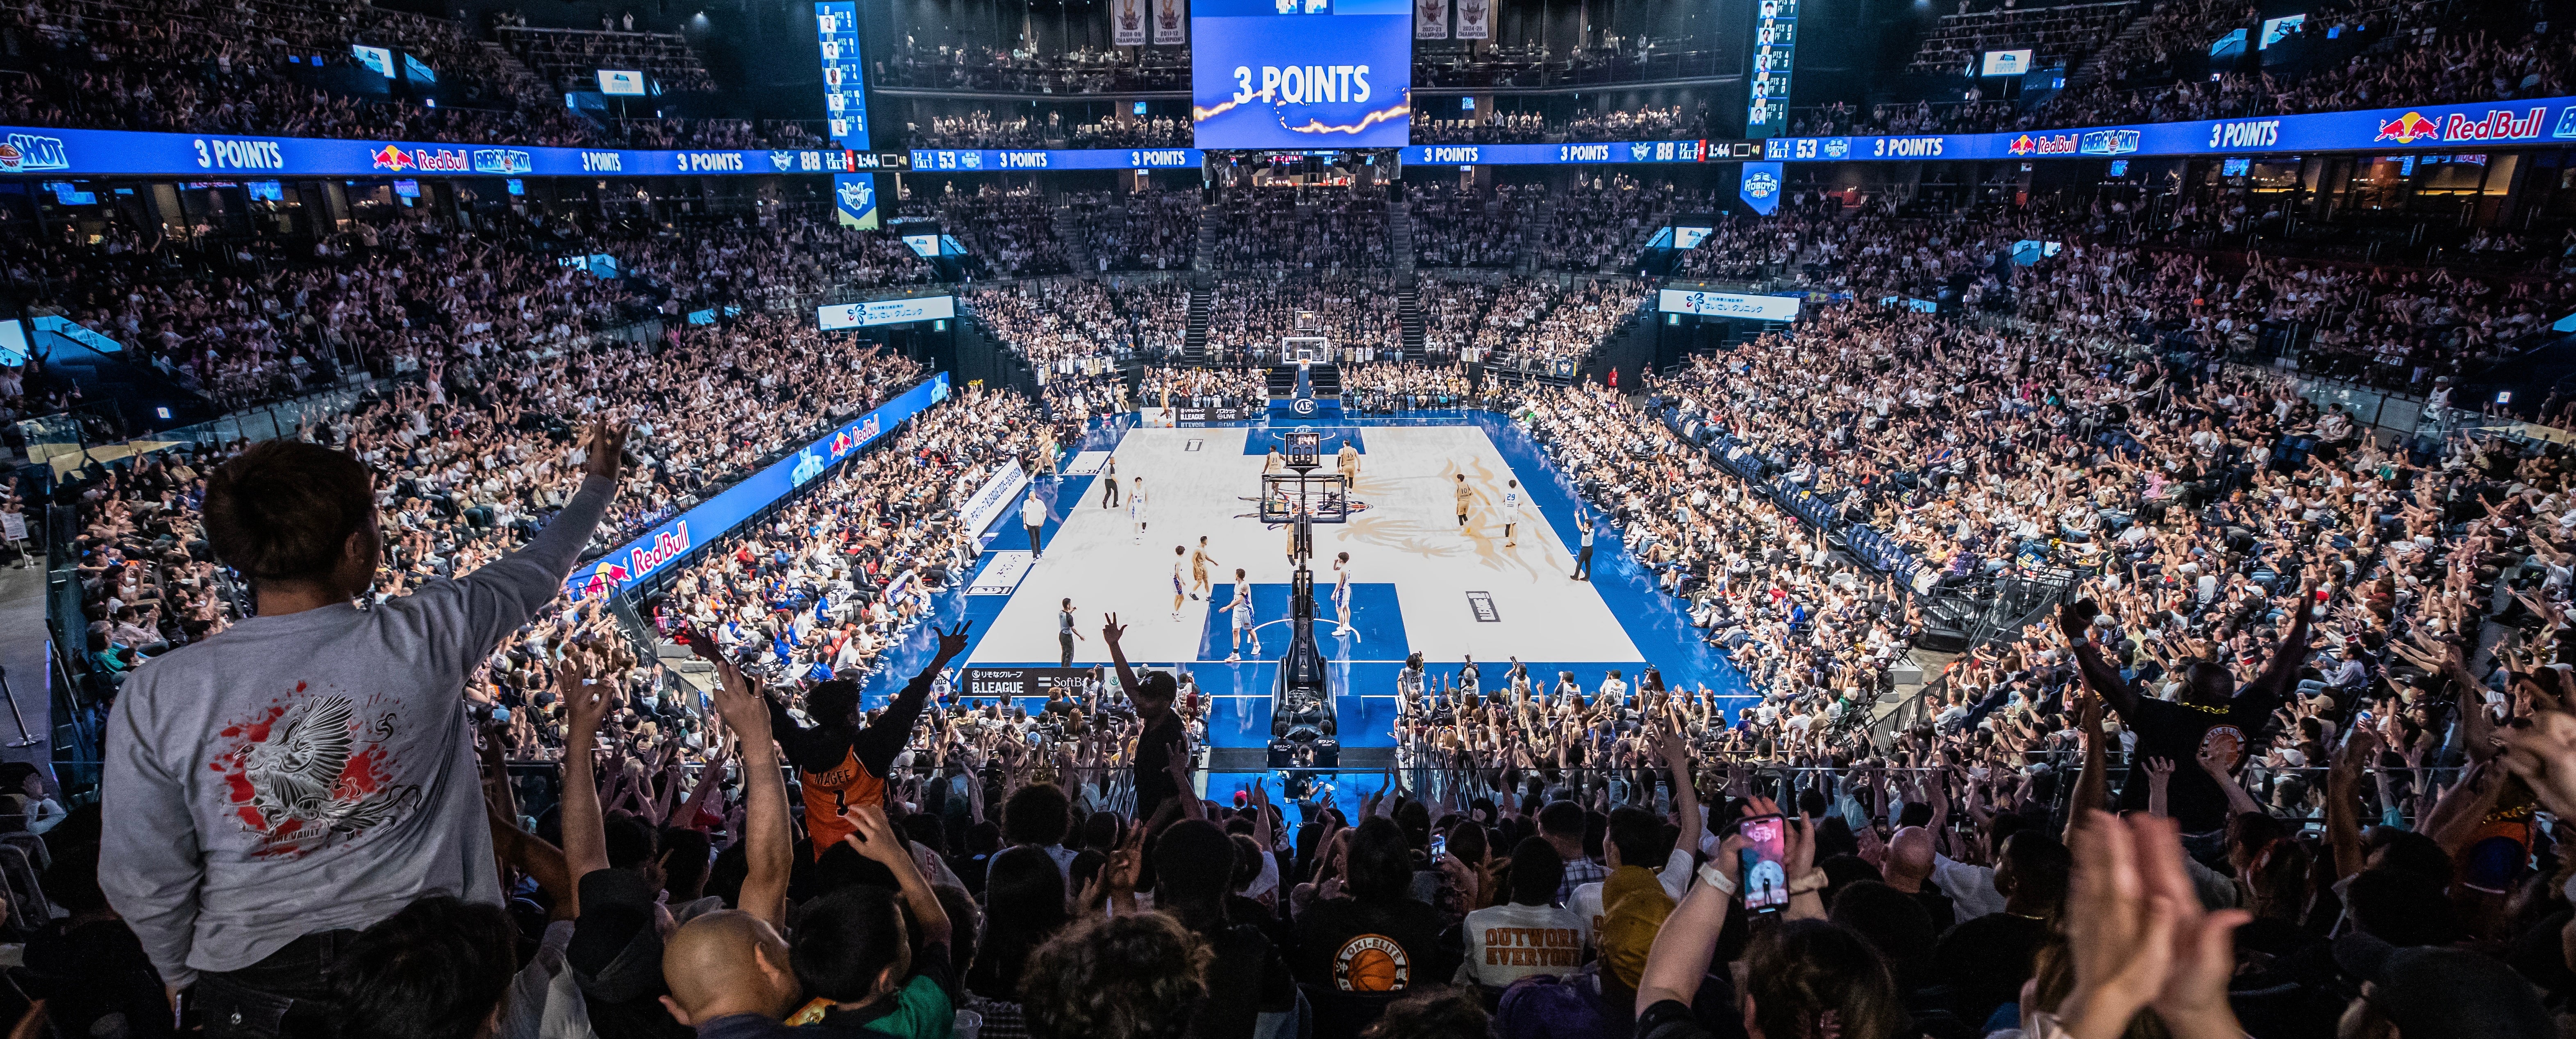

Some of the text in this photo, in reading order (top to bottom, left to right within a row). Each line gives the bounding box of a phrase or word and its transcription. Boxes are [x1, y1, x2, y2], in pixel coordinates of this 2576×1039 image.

[1233, 65, 1371, 104] 3 POINTS
[2444, 110, 2496, 141] Red
[2490, 107, 2546, 140] Bull
[2083, 131, 2139, 150] ENERGY SHOT
[2210, 120, 2279, 148] 3 POINTS
[8, 134, 66, 166] SHOT
[195, 139, 284, 168] 3 POINTS
[1561, 145, 1608, 161] 3 POINTS
[1656, 143, 1674, 160] 88
[1708, 144, 1729, 157] 1:44
[1751, 146, 1760, 155] 40
[1796, 139, 1817, 158] 53
[1874, 138, 1942, 156] 3 POINTS
[2038, 134, 2078, 154] Red Bull
[416, 149, 470, 171] Red Bull
[509, 150, 531, 170] SHOT
[582, 152, 621, 171] 3 POINTS
[677, 153, 743, 171] 3 POINTS
[800, 151, 821, 171] 88
[857, 154, 879, 168] 1:44
[938, 151, 956, 169] 53
[1000, 152, 1047, 167] 3 POINTS
[1132, 151, 1185, 166] 3 POINTS
[1424, 147, 1478, 162] 3 POINTS
[1745, 180, 1777, 191] ROBOTS
[853, 414, 879, 447] Red Bull
[985, 466, 1022, 507] B.LEAGUE SEASON
[632, 520, 689, 577] Red Bull
[972, 682, 1024, 693] B.LEAGUE
[1054, 677, 1087, 687] SoftBa
[1347, 938, 1402, 962] OKI-ELITE
